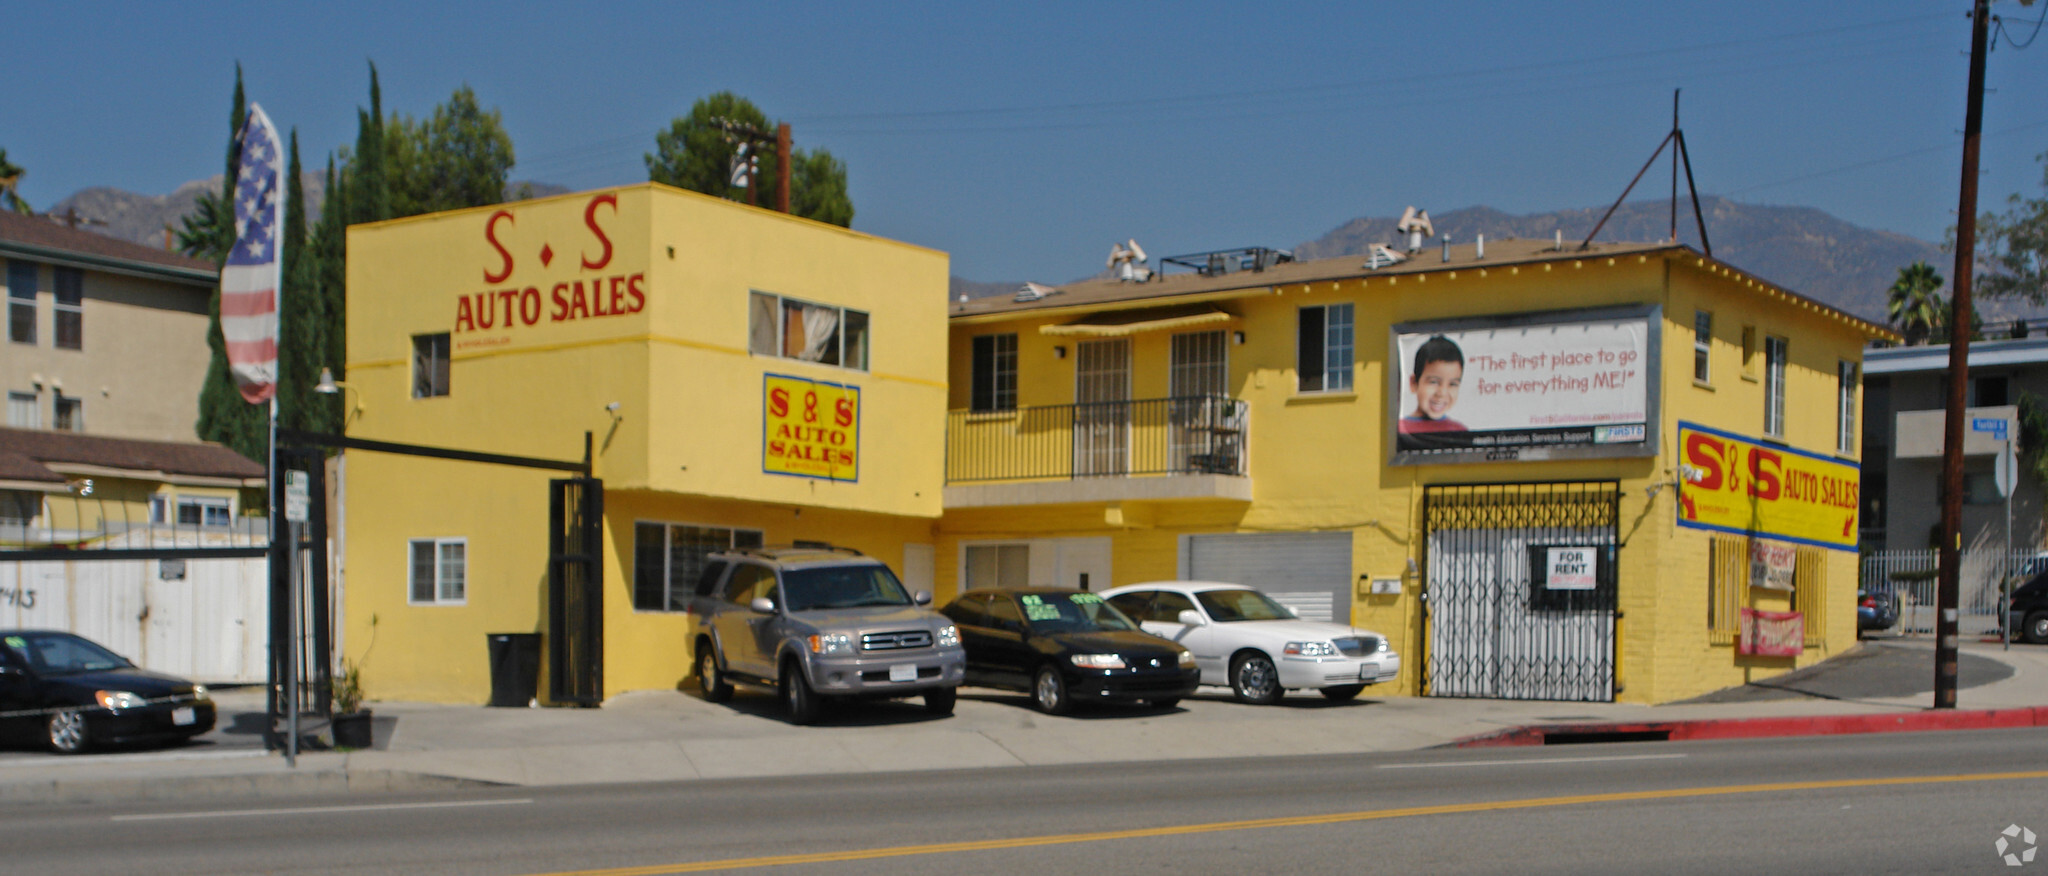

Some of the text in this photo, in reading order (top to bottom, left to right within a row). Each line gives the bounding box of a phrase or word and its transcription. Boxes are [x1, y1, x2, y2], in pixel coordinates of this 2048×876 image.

[483, 194, 617, 284] S S
[455, 272, 645, 332] AUTO SALES
[1469, 348, 1638, 371] "The first place to go
[1477, 370, 1636, 396] for everything ME!"
[769, 387, 854, 427] S & S
[776, 423, 846, 446] AUTO
[769, 440, 854, 466] SALES
[1686, 431, 1859, 510] S & S AUTO SALES
[1559, 551, 1584, 562] FOR
[1750, 541, 1796, 568] FOR RENT
[1555, 563, 1588, 575] RENT
